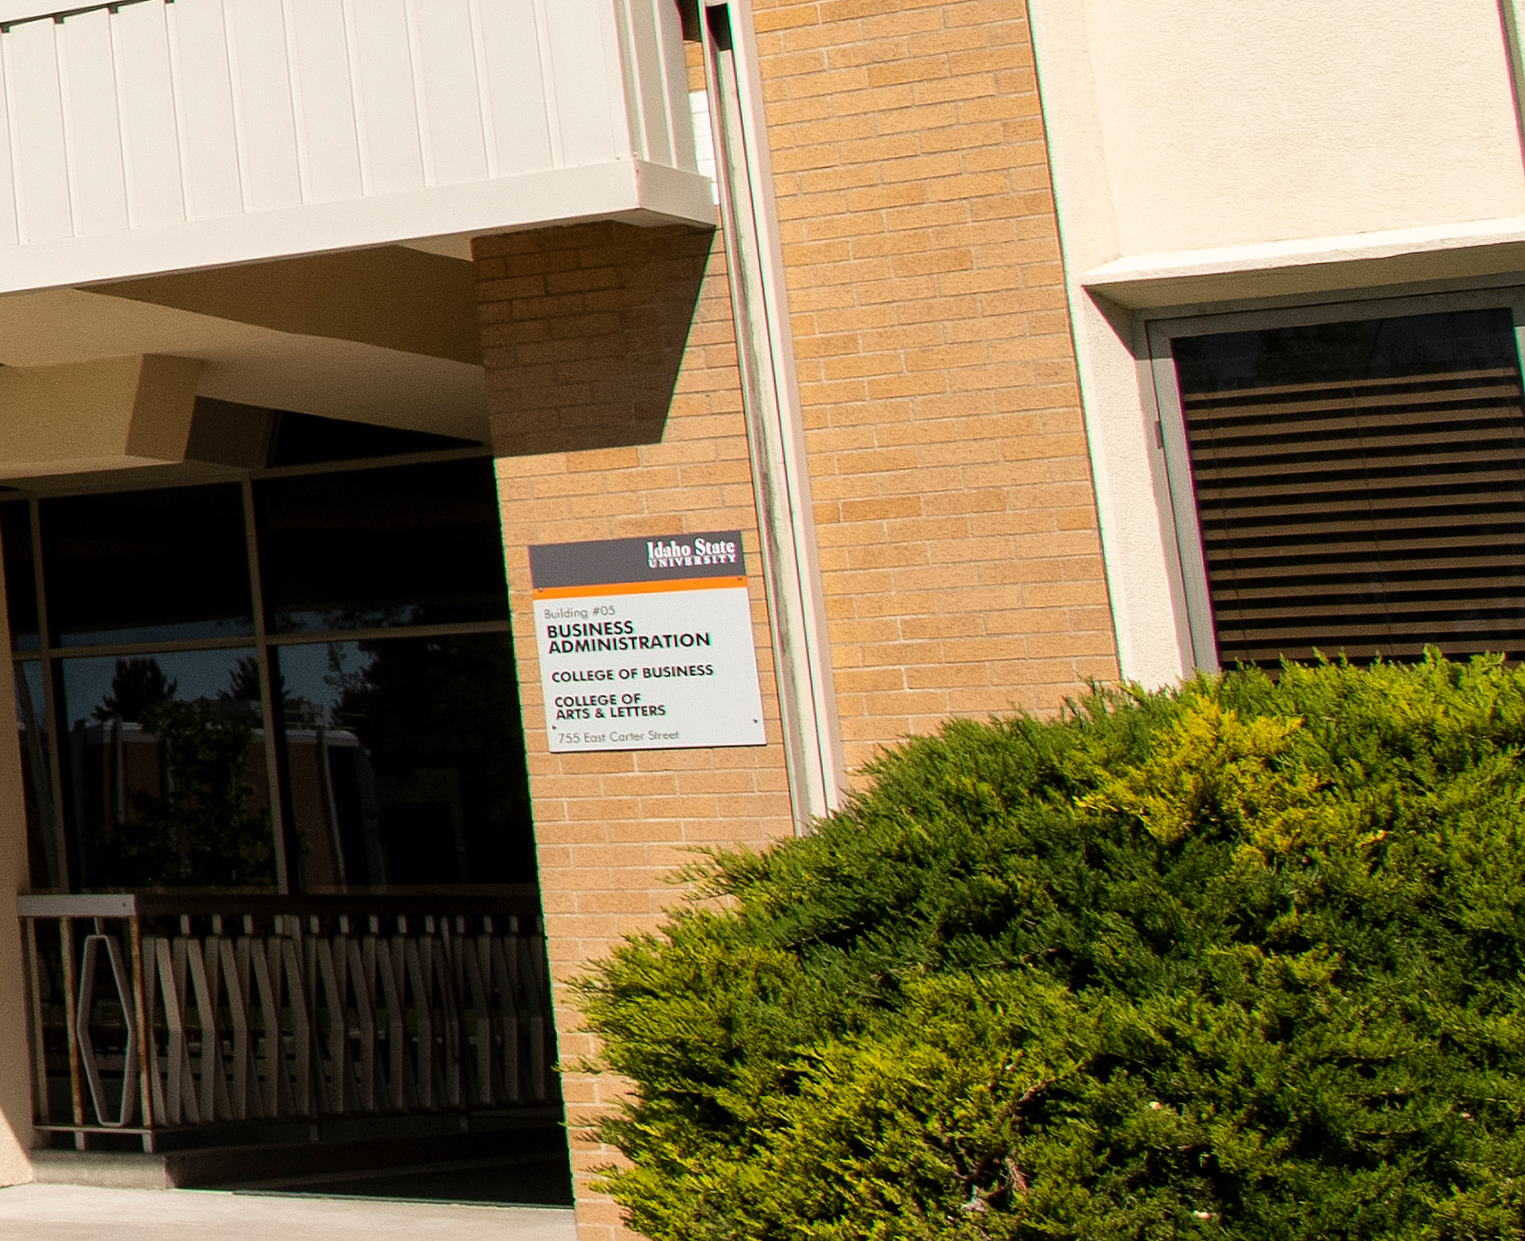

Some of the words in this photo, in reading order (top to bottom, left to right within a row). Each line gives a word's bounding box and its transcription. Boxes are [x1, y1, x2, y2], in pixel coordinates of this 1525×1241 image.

[647, 540, 691, 559] Idaho
[694, 538, 735, 555] State
[648, 554, 736, 568] UNIVERSITY
[544, 607, 588, 619] Building
[592, 605, 615, 616] #05
[547, 621, 634, 638] BUSINESS
[548, 632, 711, 654] ADMINISTRATION
[551, 669, 614, 683] COLLEGE
[618, 668, 638, 680] OF
[642, 664, 714, 679] BUSINESS
[554, 694, 617, 707] COLLEGE
[621, 693, 641, 705] OF
[556, 708, 590, 720] ARTS
[595, 708, 605, 719] &
[610, 705, 666, 718] LETTERS
[558, 733, 580, 744] 755
[583, 732, 605, 743] East
[609, 731, 644, 742] Carter
[647, 729, 679, 741] Street
